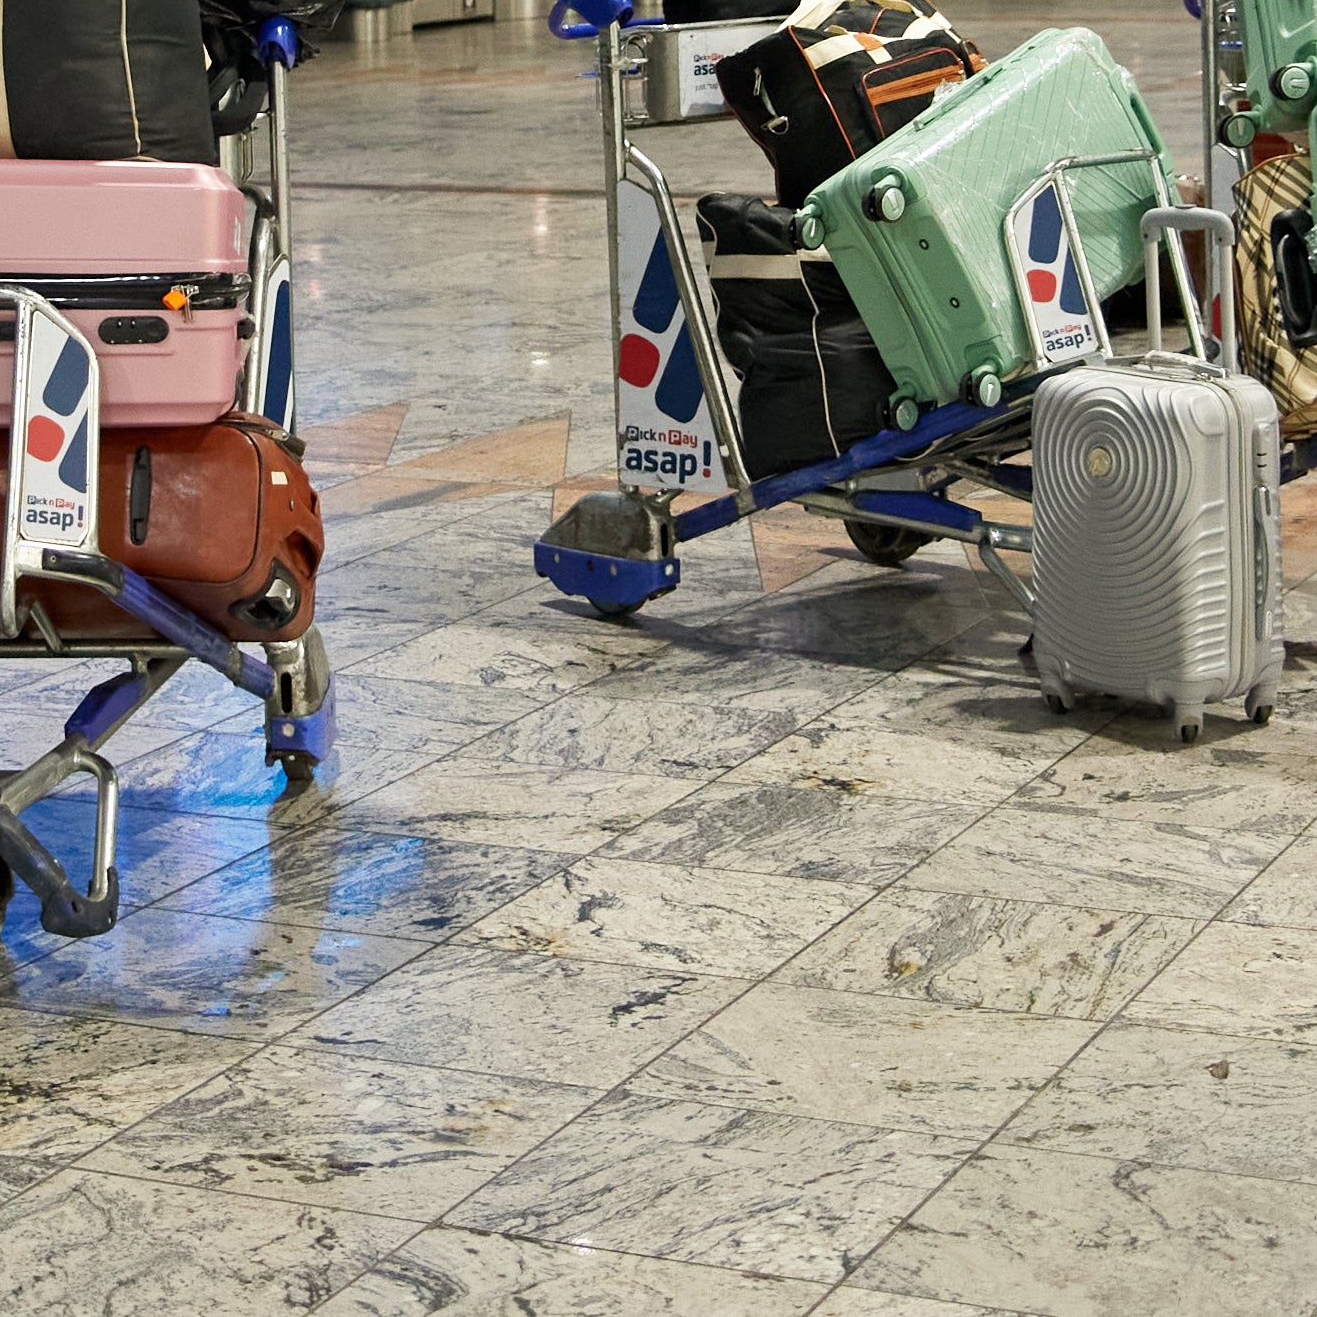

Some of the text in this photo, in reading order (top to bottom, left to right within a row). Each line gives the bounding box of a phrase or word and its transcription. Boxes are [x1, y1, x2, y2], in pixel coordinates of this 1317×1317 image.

[694, 64, 716, 76] asa
[1046, 324, 1092, 351] asap!
[625, 425, 698, 448] Pick n Pay
[625, 440, 711, 484] asap!
[26, 505, 84, 531] asap!
